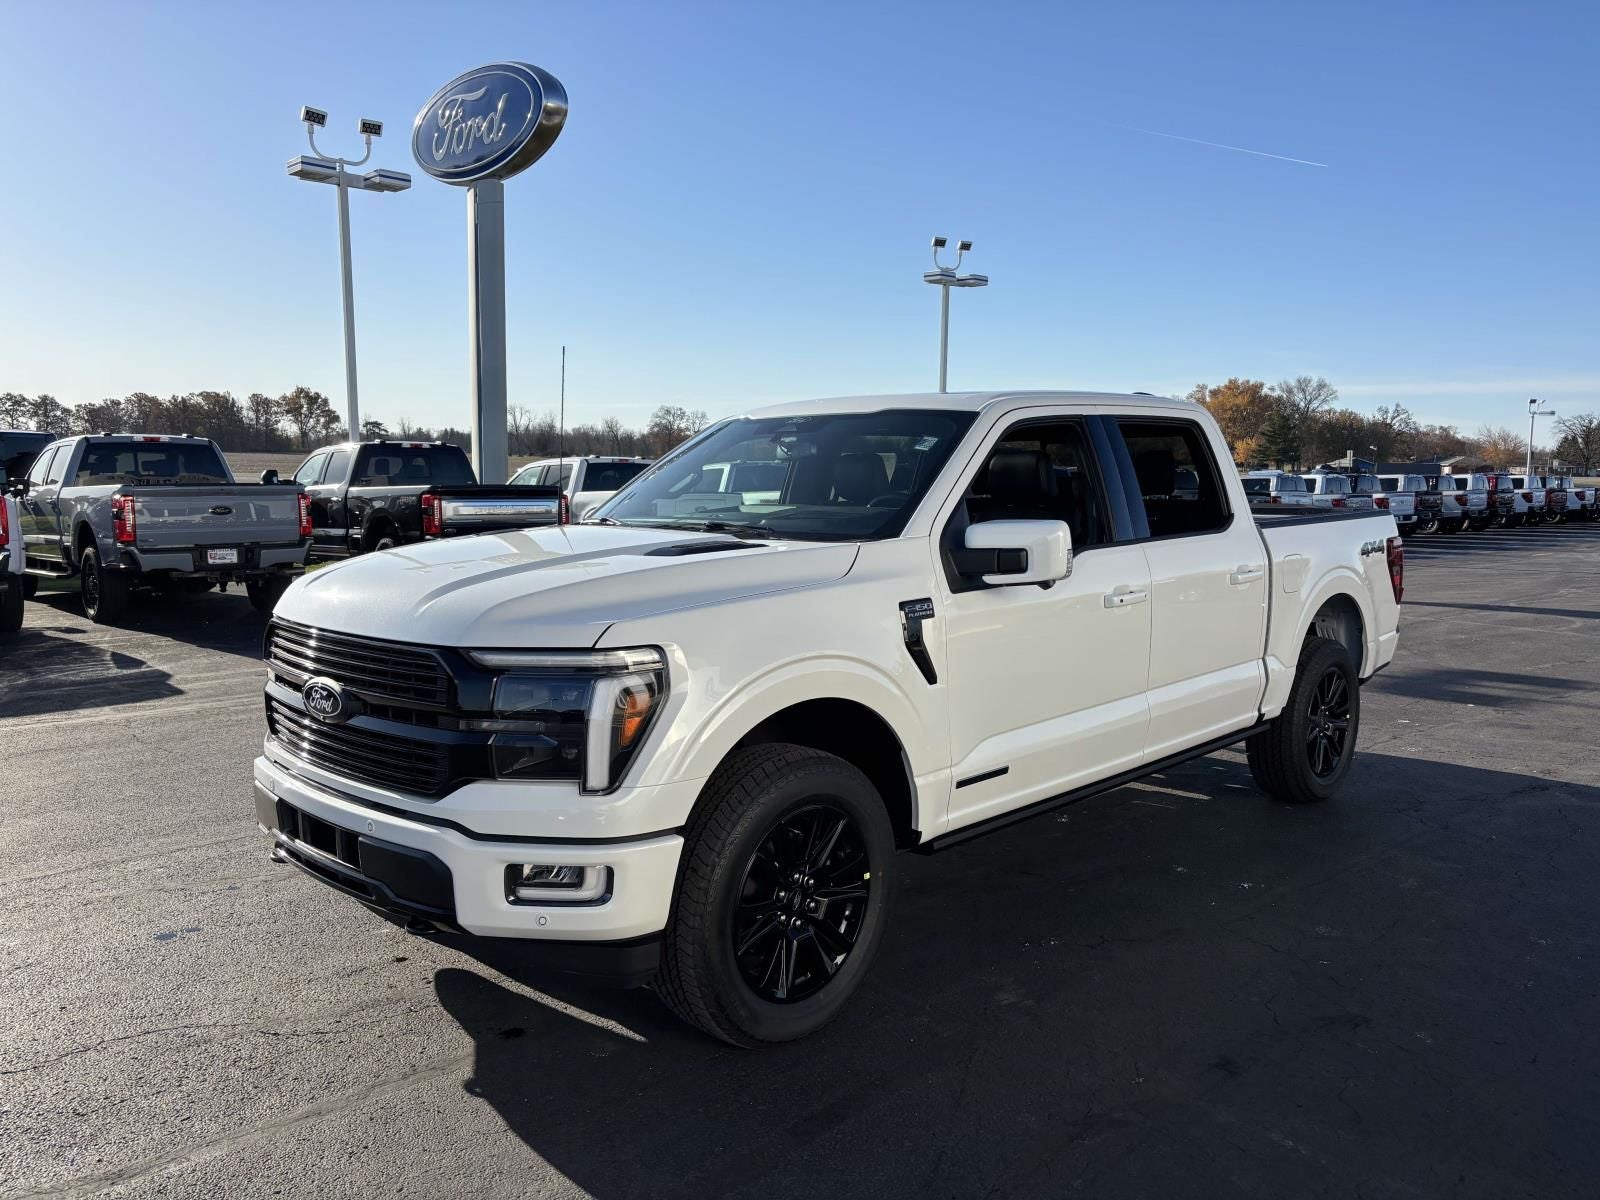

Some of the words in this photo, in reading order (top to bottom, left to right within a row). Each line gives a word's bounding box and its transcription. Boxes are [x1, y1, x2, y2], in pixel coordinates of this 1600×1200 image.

[432, 85, 509, 161] Ford
[905, 602, 932, 612] F-150
[310, 687, 334, 712] Ford
